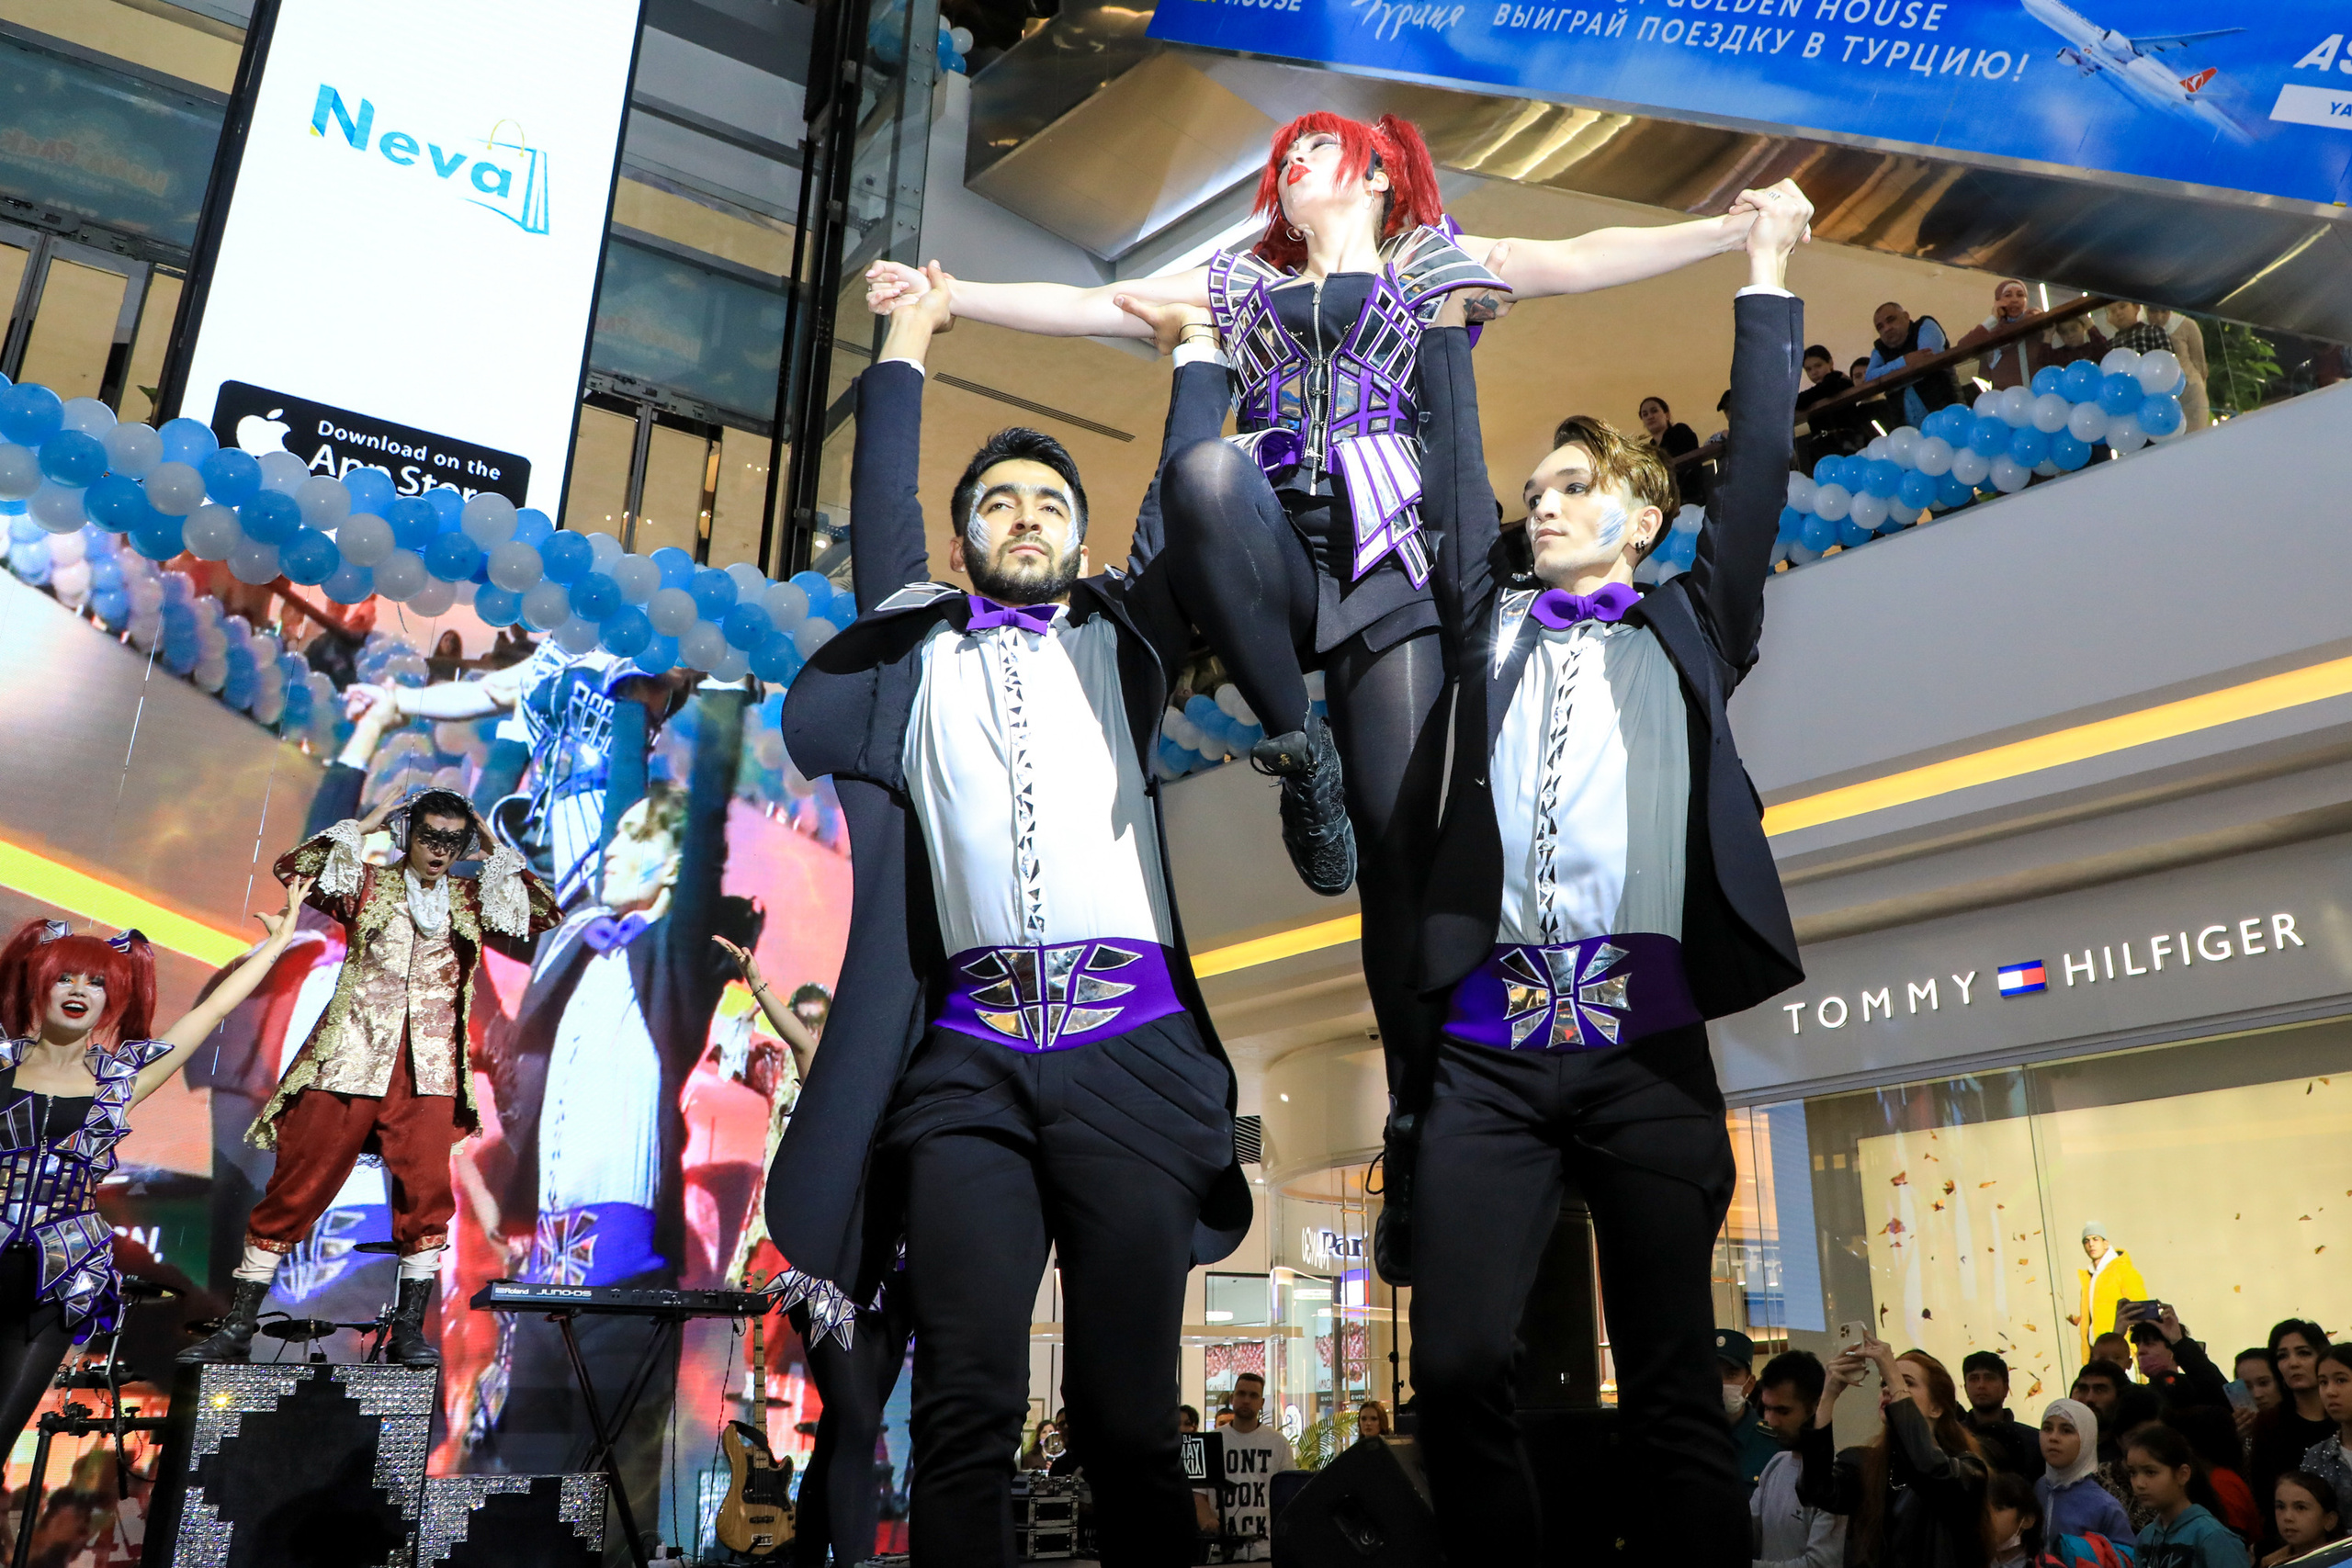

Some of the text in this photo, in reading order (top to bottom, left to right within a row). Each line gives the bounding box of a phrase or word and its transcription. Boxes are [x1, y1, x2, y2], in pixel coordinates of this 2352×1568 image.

[1815, 0, 1948, 31] HOUSE
[1492, 4, 2030, 83] ВЫИГРАЙ ПОЕЗДКУ В ТУРЦИЮ!
[310, 83, 513, 198] Neva
[317, 419, 502, 481] Download on the
[308, 444, 479, 503] Ap Str
[1783, 913, 2306, 1034] TOMMY HILFIGER
[504, 1287, 593, 1297] Roland JUNO-DS
[1182, 1434, 1192, 1444] DJ
[1226, 1449, 1272, 1473] ONT
[1224, 1482, 1266, 1507] OOK
[1227, 1516, 1268, 1537] ACK
